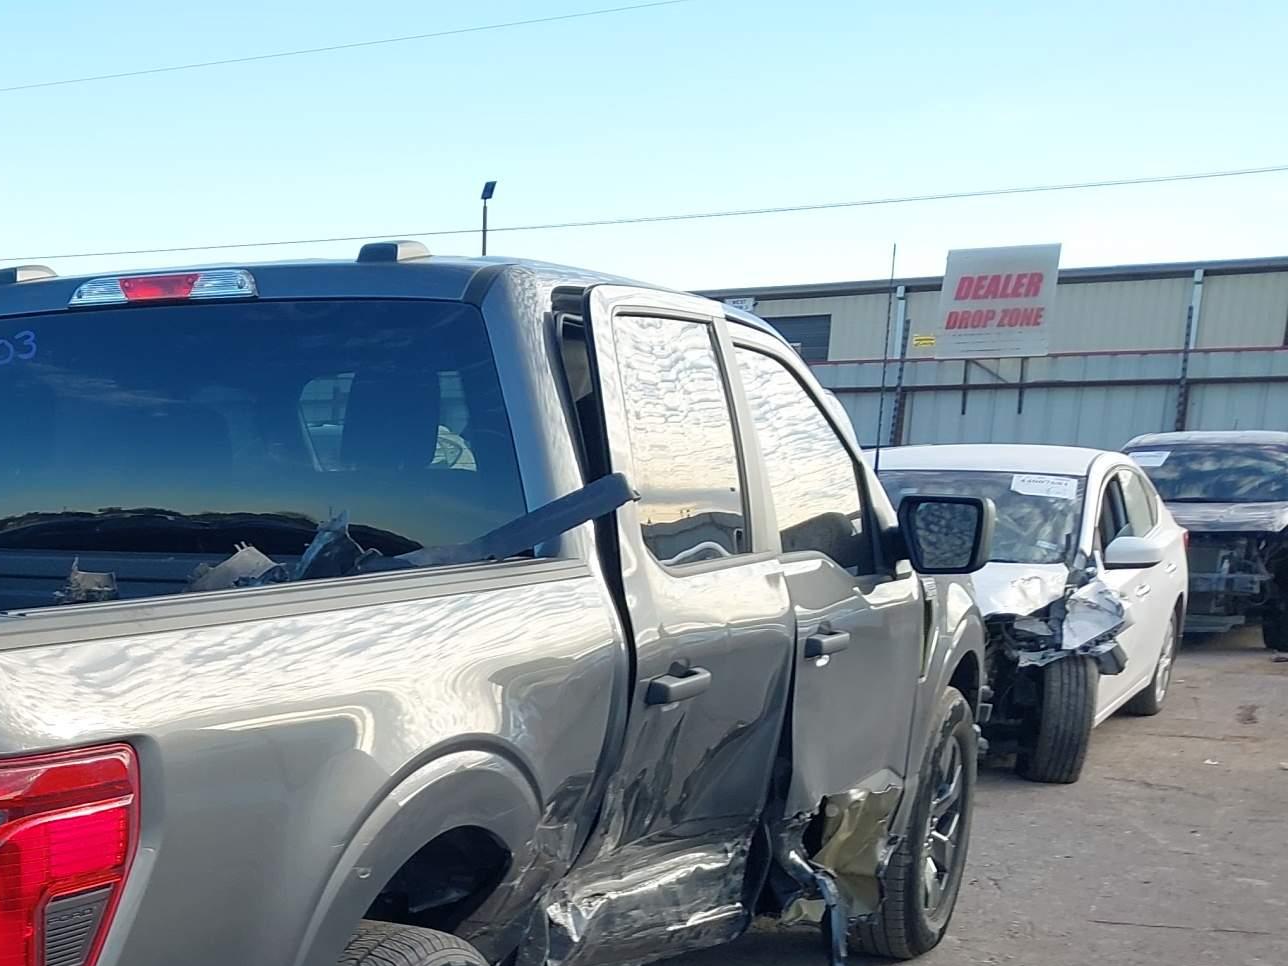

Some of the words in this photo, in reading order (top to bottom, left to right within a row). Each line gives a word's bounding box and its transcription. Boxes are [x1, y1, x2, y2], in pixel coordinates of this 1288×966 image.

[954, 271, 1044, 301] DEALER
[945, 309, 996, 330] DROP
[996, 307, 1045, 328] ZONE
